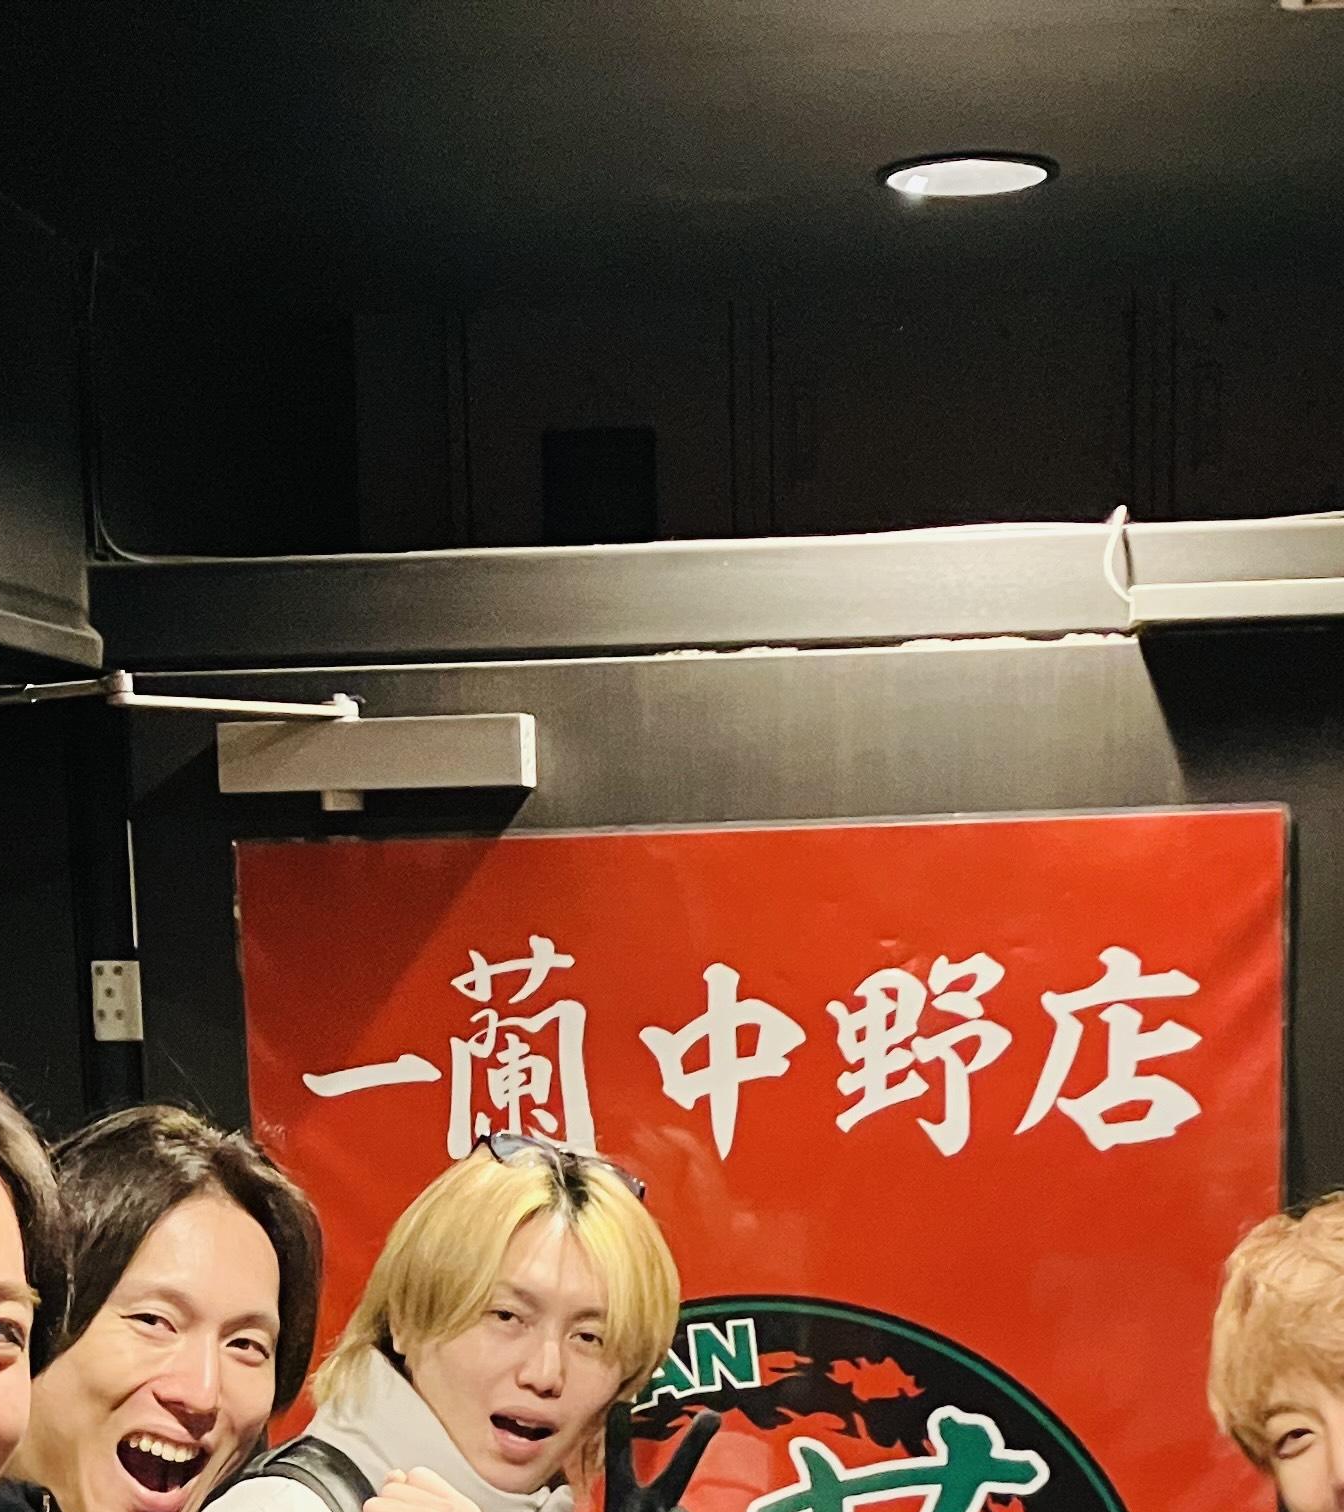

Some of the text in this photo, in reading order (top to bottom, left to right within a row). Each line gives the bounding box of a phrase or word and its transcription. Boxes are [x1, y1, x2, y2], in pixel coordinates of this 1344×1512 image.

[301, 934, 1203, 1159] 一蘭中野店
